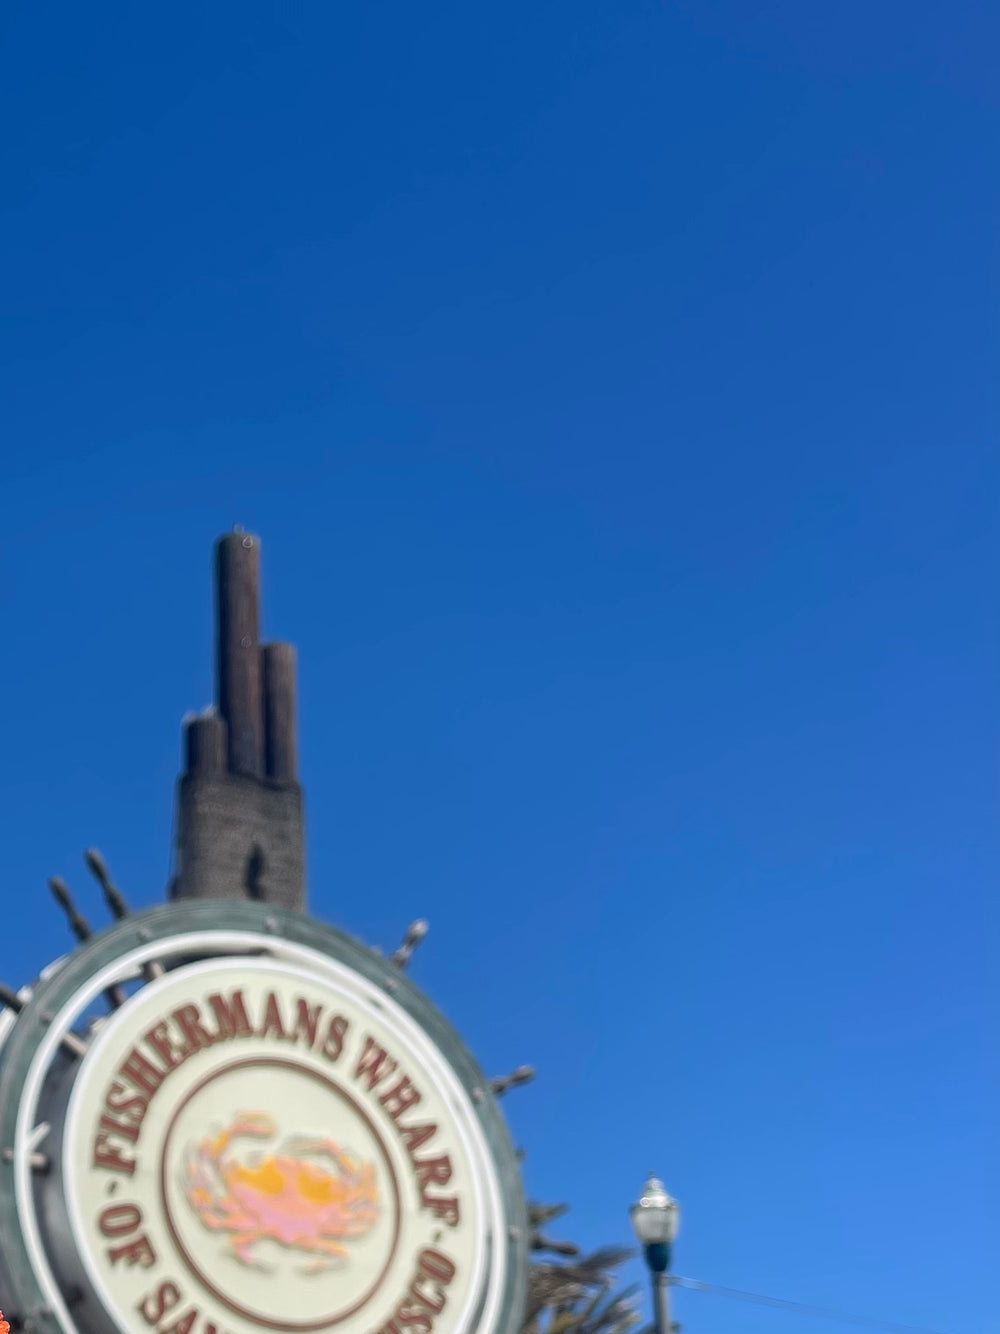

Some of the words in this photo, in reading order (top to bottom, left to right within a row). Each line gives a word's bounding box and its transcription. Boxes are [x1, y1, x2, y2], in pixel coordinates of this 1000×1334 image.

[92, 988, 350, 1175] FISHERMANS
[354, 1034, 460, 1227] WHARF
[99, 1201, 157, 1270] OF
